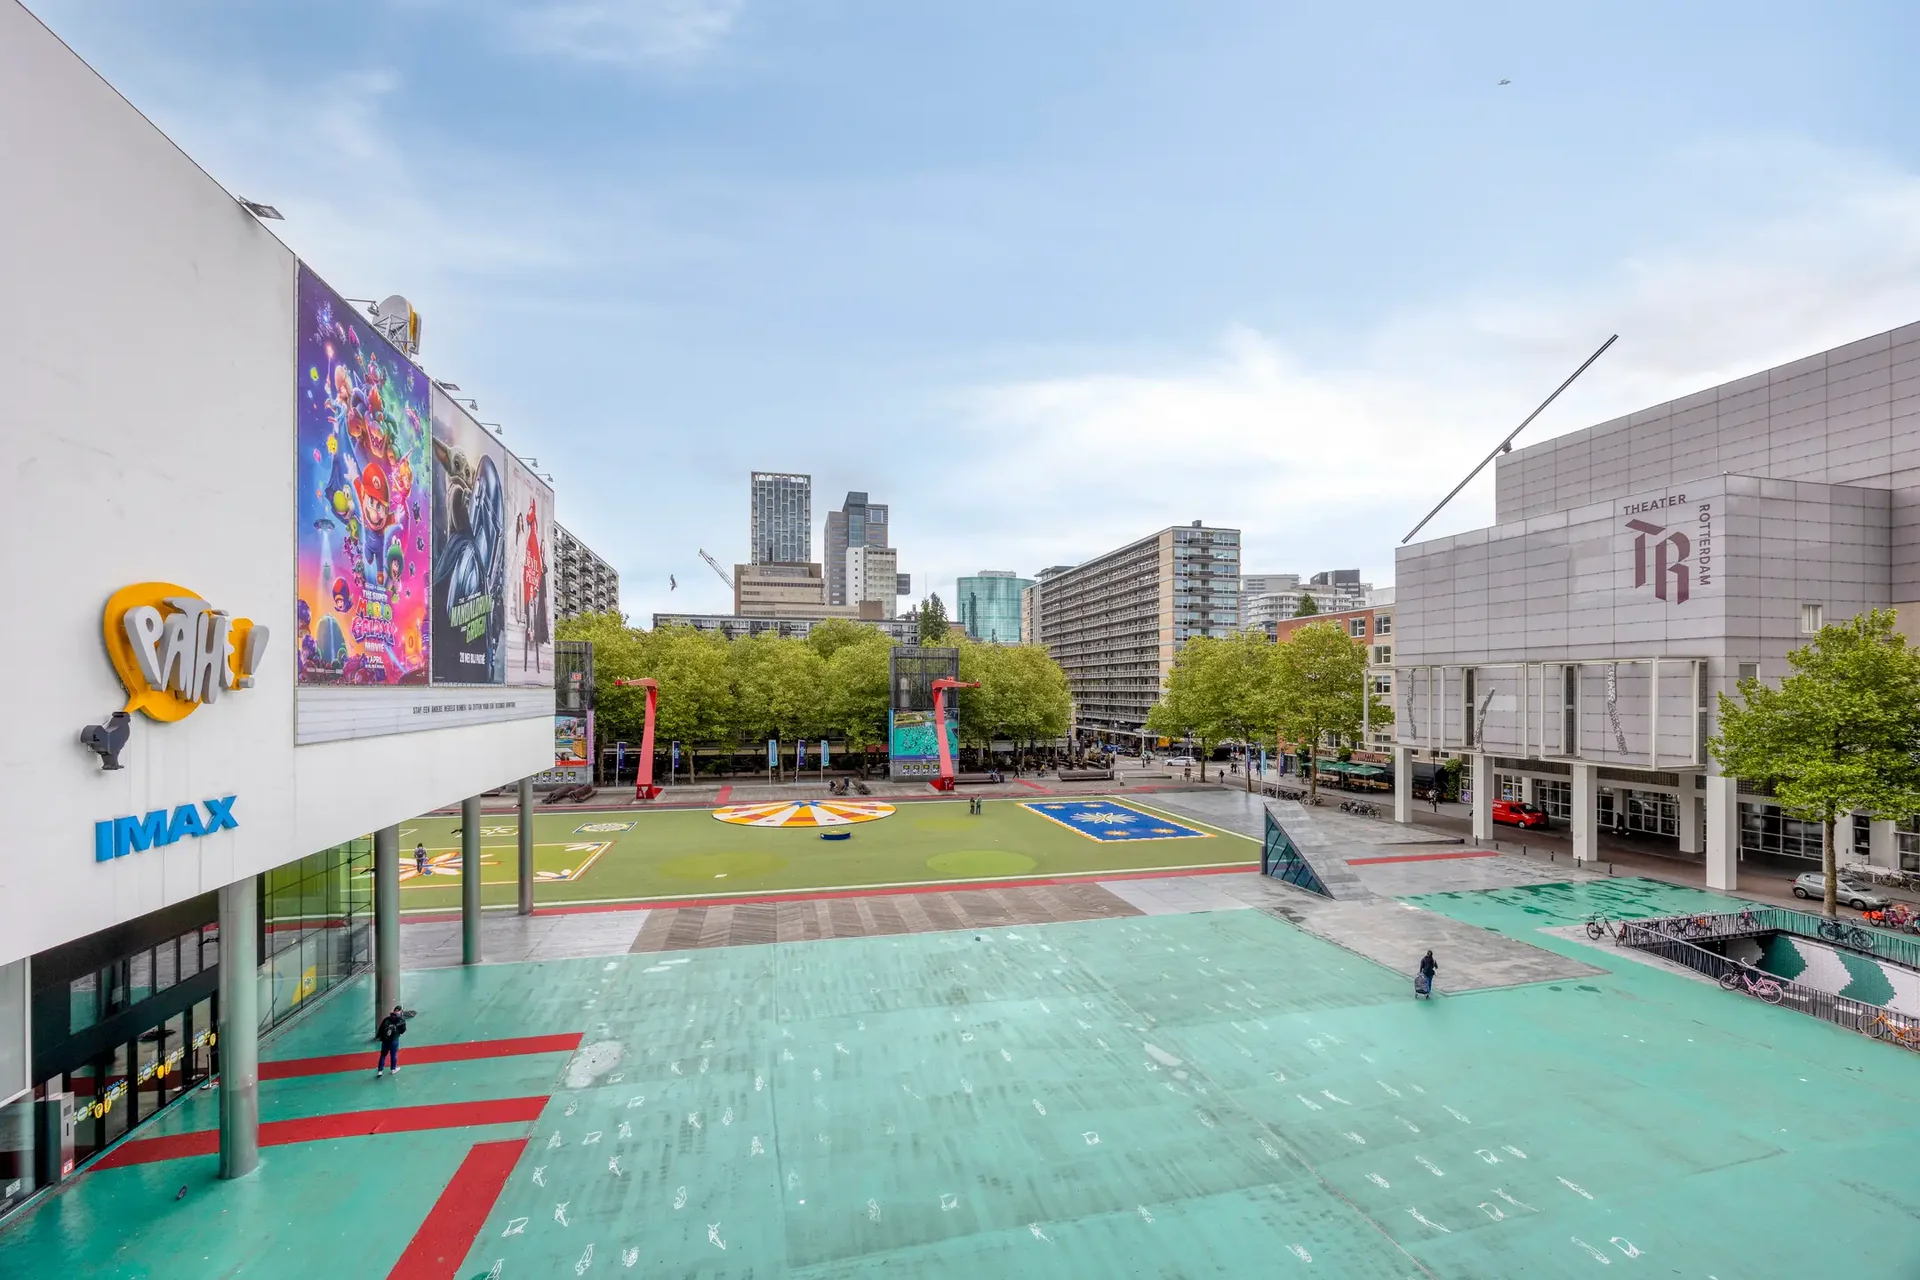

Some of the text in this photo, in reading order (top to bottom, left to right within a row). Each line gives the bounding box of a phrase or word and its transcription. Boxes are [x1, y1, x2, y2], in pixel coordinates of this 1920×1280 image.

[1624, 494, 1687, 515] THEATER
[1624, 518, 1691, 605] TR
[1699, 504, 1711, 586] ROTTERDAM
[356, 596, 393, 621] MARIO
[364, 641, 385, 652] MOVIE
[95, 795, 240, 862] IMAX
